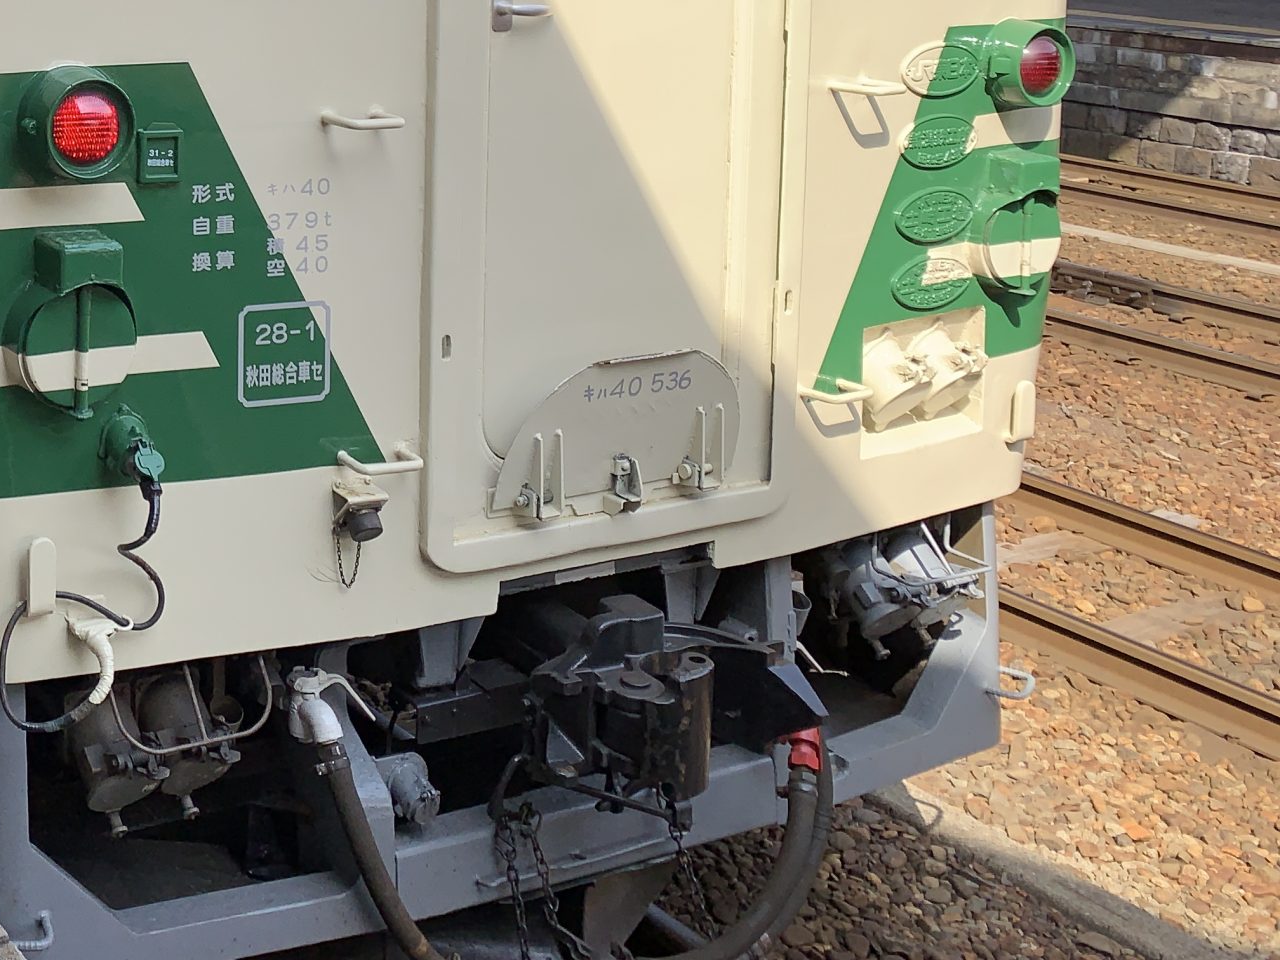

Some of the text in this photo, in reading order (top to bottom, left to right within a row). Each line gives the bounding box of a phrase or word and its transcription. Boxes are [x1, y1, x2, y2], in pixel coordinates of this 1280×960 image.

[192, 177, 330, 204] 形式 キハ40
[192, 214, 235, 236] 自重
[192, 250, 235, 272] 換算
[266, 258, 286, 277] 空
[255, 320, 315, 346] 28-1
[245, 360, 323, 388] 秋田総合車セ
[583, 369, 692, 403] キハ40 536
